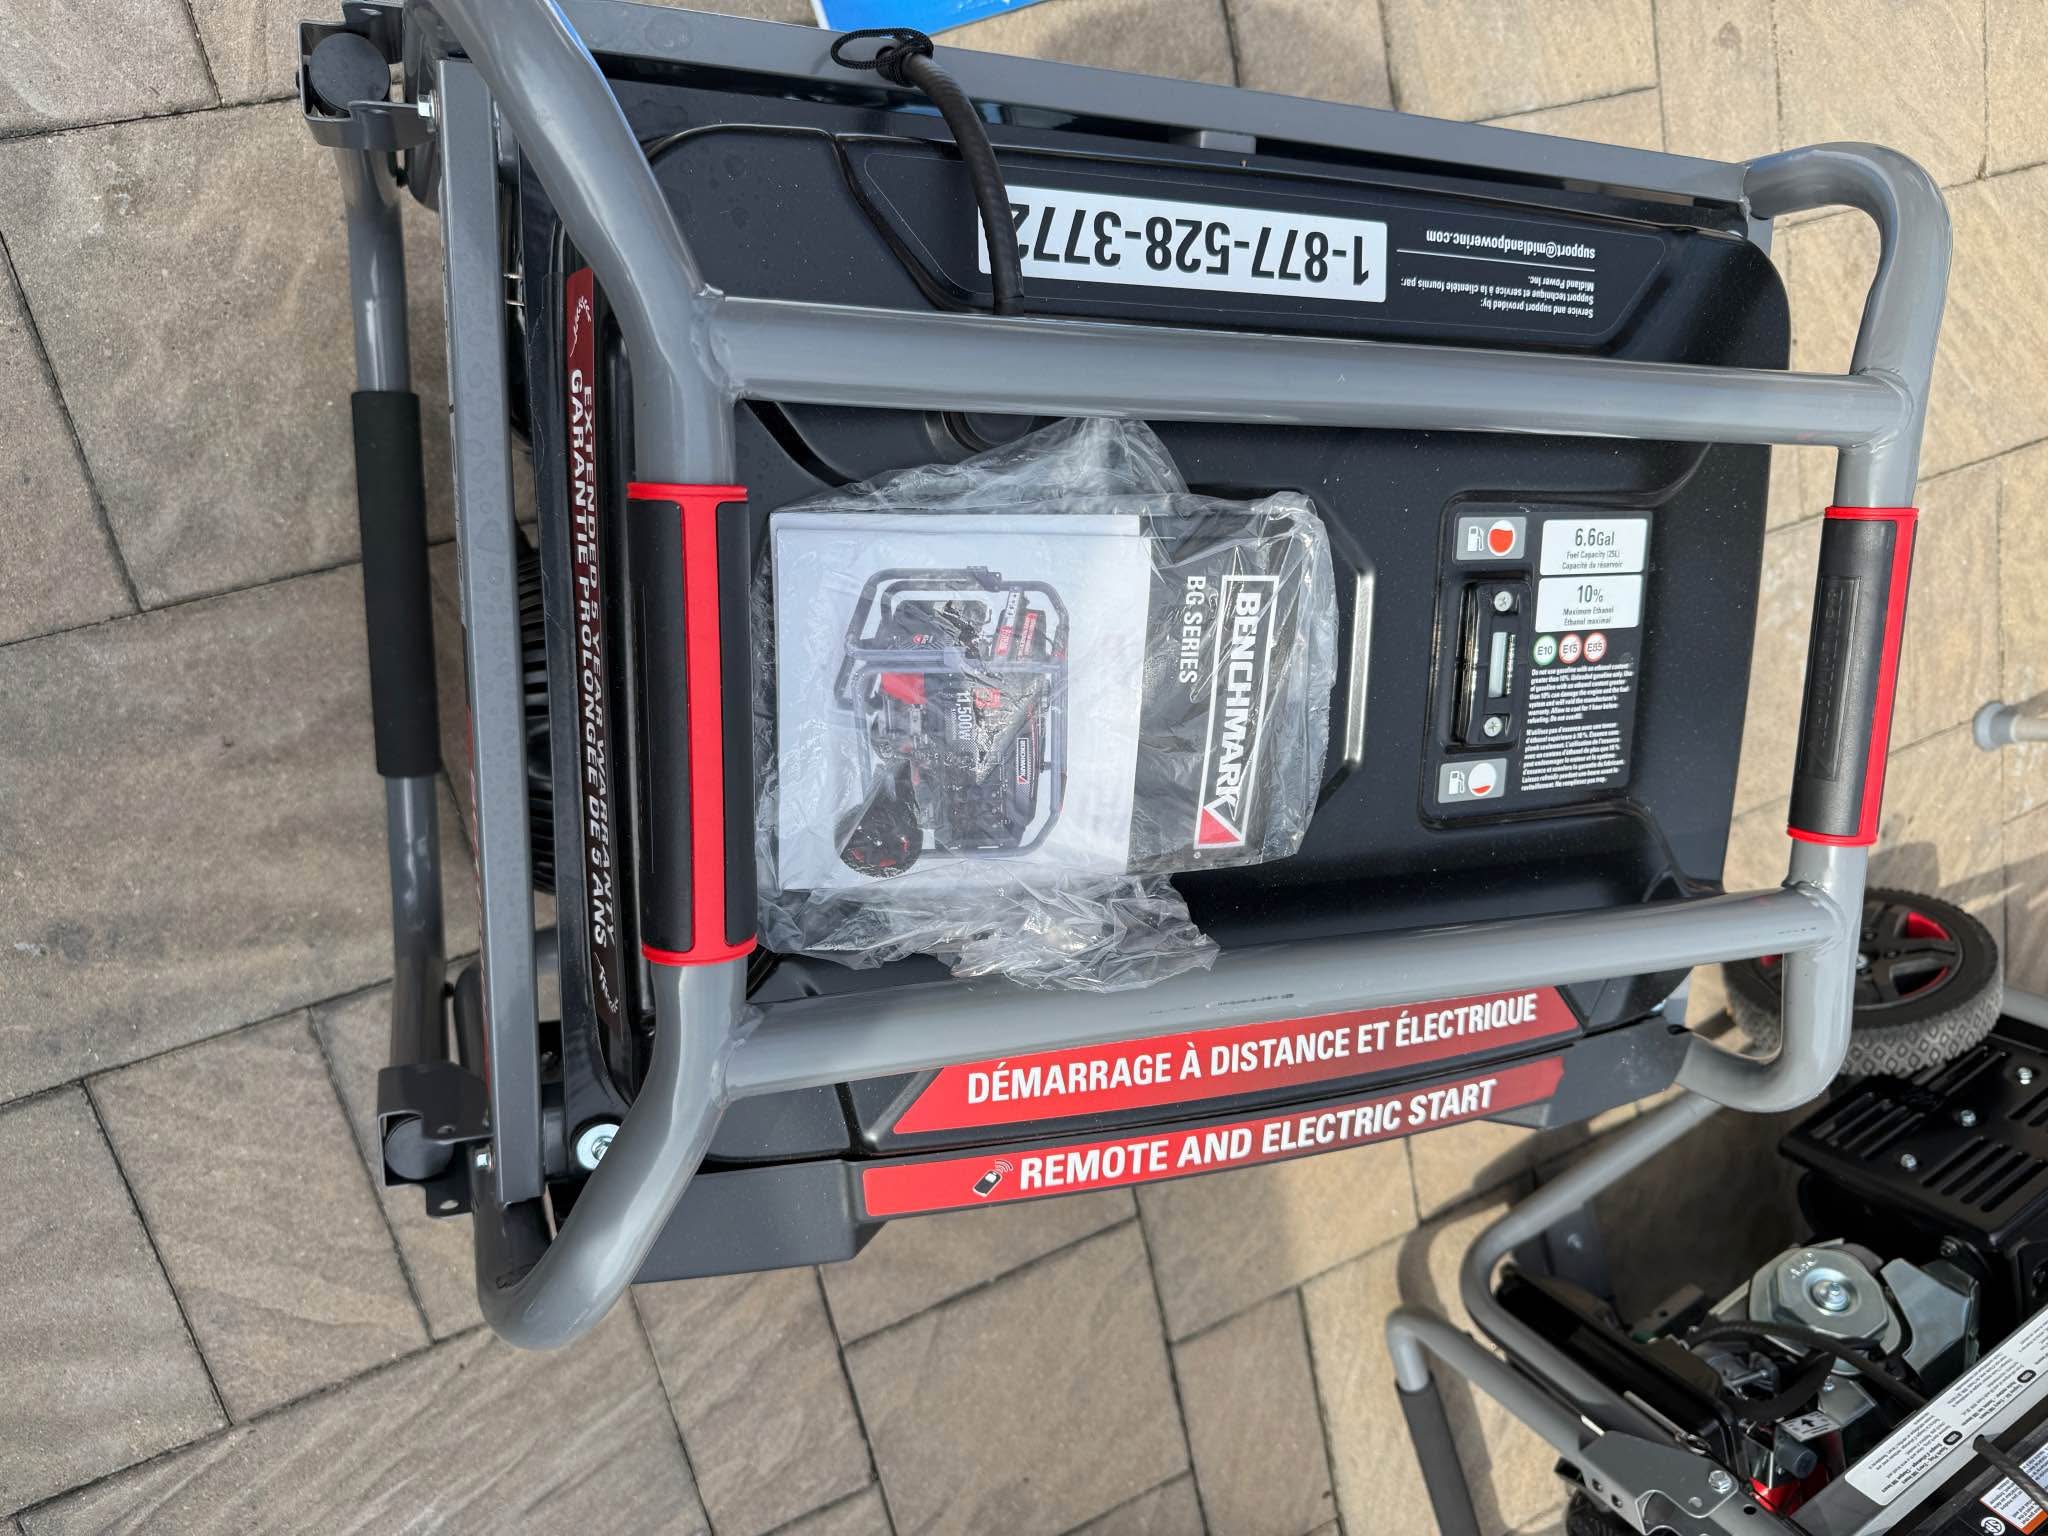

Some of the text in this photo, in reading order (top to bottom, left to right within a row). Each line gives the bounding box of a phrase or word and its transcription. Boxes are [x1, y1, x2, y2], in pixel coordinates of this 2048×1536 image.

[1426, 230, 1596, 259] support@midlandpowerinc.com
[1401, 276, 1594, 305] Support technique et service à la clientèle fournis par:
[1528, 275, 1595, 292] Midland Power Inc.
[1480, 297, 1593, 319] Service and support provided by:
[570, 369, 589, 565] GARANTIE
[1574, 527, 1615, 547] 6.6Gal
[1566, 551, 1579, 559] Fuel
[1580, 550, 1605, 560] Capacity
[1589, 561, 1596, 569] du
[1577, 584, 1603, 604] 10%
[1562, 606, 1614, 616] Maximum Ethanol
[1587, 617, 1611, 625] maximal
[1179, 575, 1206, 684] BG SERIES
[1537, 645, 1553, 656] E10
[1562, 643, 1578, 655] E15
[583, 386, 615, 948] EXTENDED 5 YEAR WARRANTY
[1215, 591, 1261, 810] BENCHMARK
[589, 795, 600, 840] DE
[591, 847, 602, 866] 5
[592, 871, 607, 948] ANS
[968, 993, 1538, 1105] DÉMARRAGE À DISTANCE ET ÉLECTRIQUE
[1020, 1078, 1498, 1191] REMOTE AND ELECTRIC START
